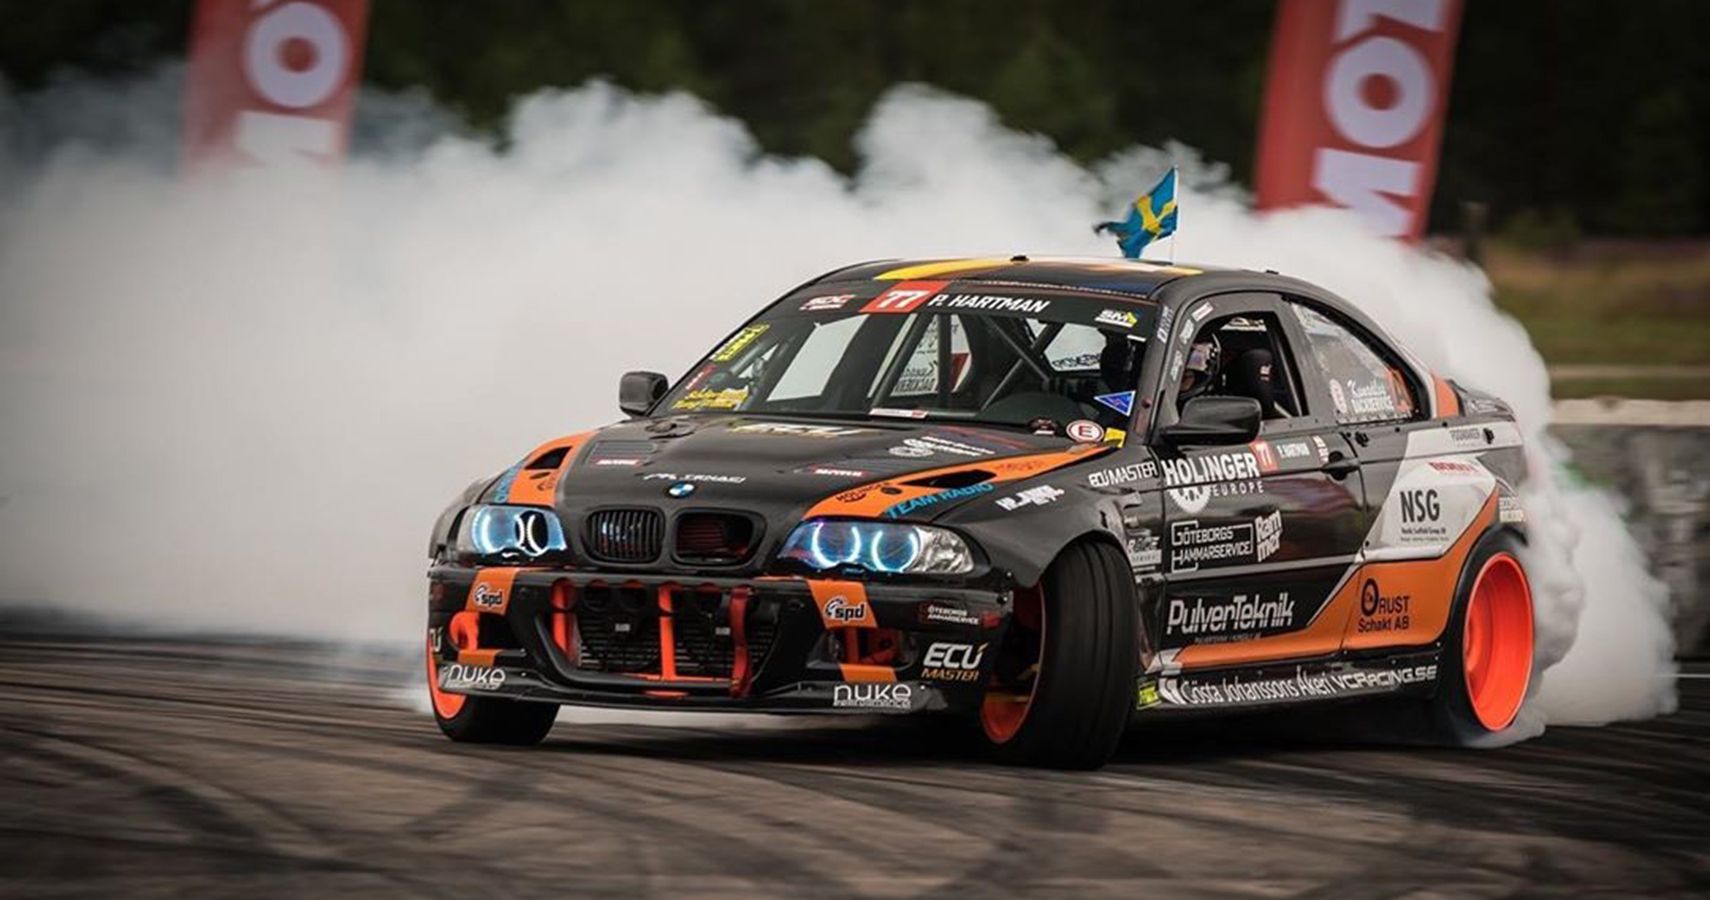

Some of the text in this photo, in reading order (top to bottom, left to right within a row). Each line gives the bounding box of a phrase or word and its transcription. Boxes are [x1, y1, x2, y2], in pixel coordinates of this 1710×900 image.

[884, 289, 928, 308] 77
[948, 294, 1051, 313] HARTMAN
[1079, 425, 1093, 438] E
[1161, 452, 1260, 487] HOLINGER
[1211, 480, 1264, 498] EUROPE
[886, 494, 938, 519] TEAM
[939, 481, 994, 502] RADIO
[1400, 489, 1440, 524] NSG
[481, 591, 503, 612] spd
[834, 602, 865, 621] spd
[1166, 592, 1295, 635] PulverTeknik
[1358, 614, 1411, 633] Schakt AB
[922, 642, 989, 669] ECU
[448, 664, 506, 684] nuke
[920, 668, 980, 681] MASTER
[833, 684, 912, 701] nuke
[1222, 675, 1299, 702] Johanssons
